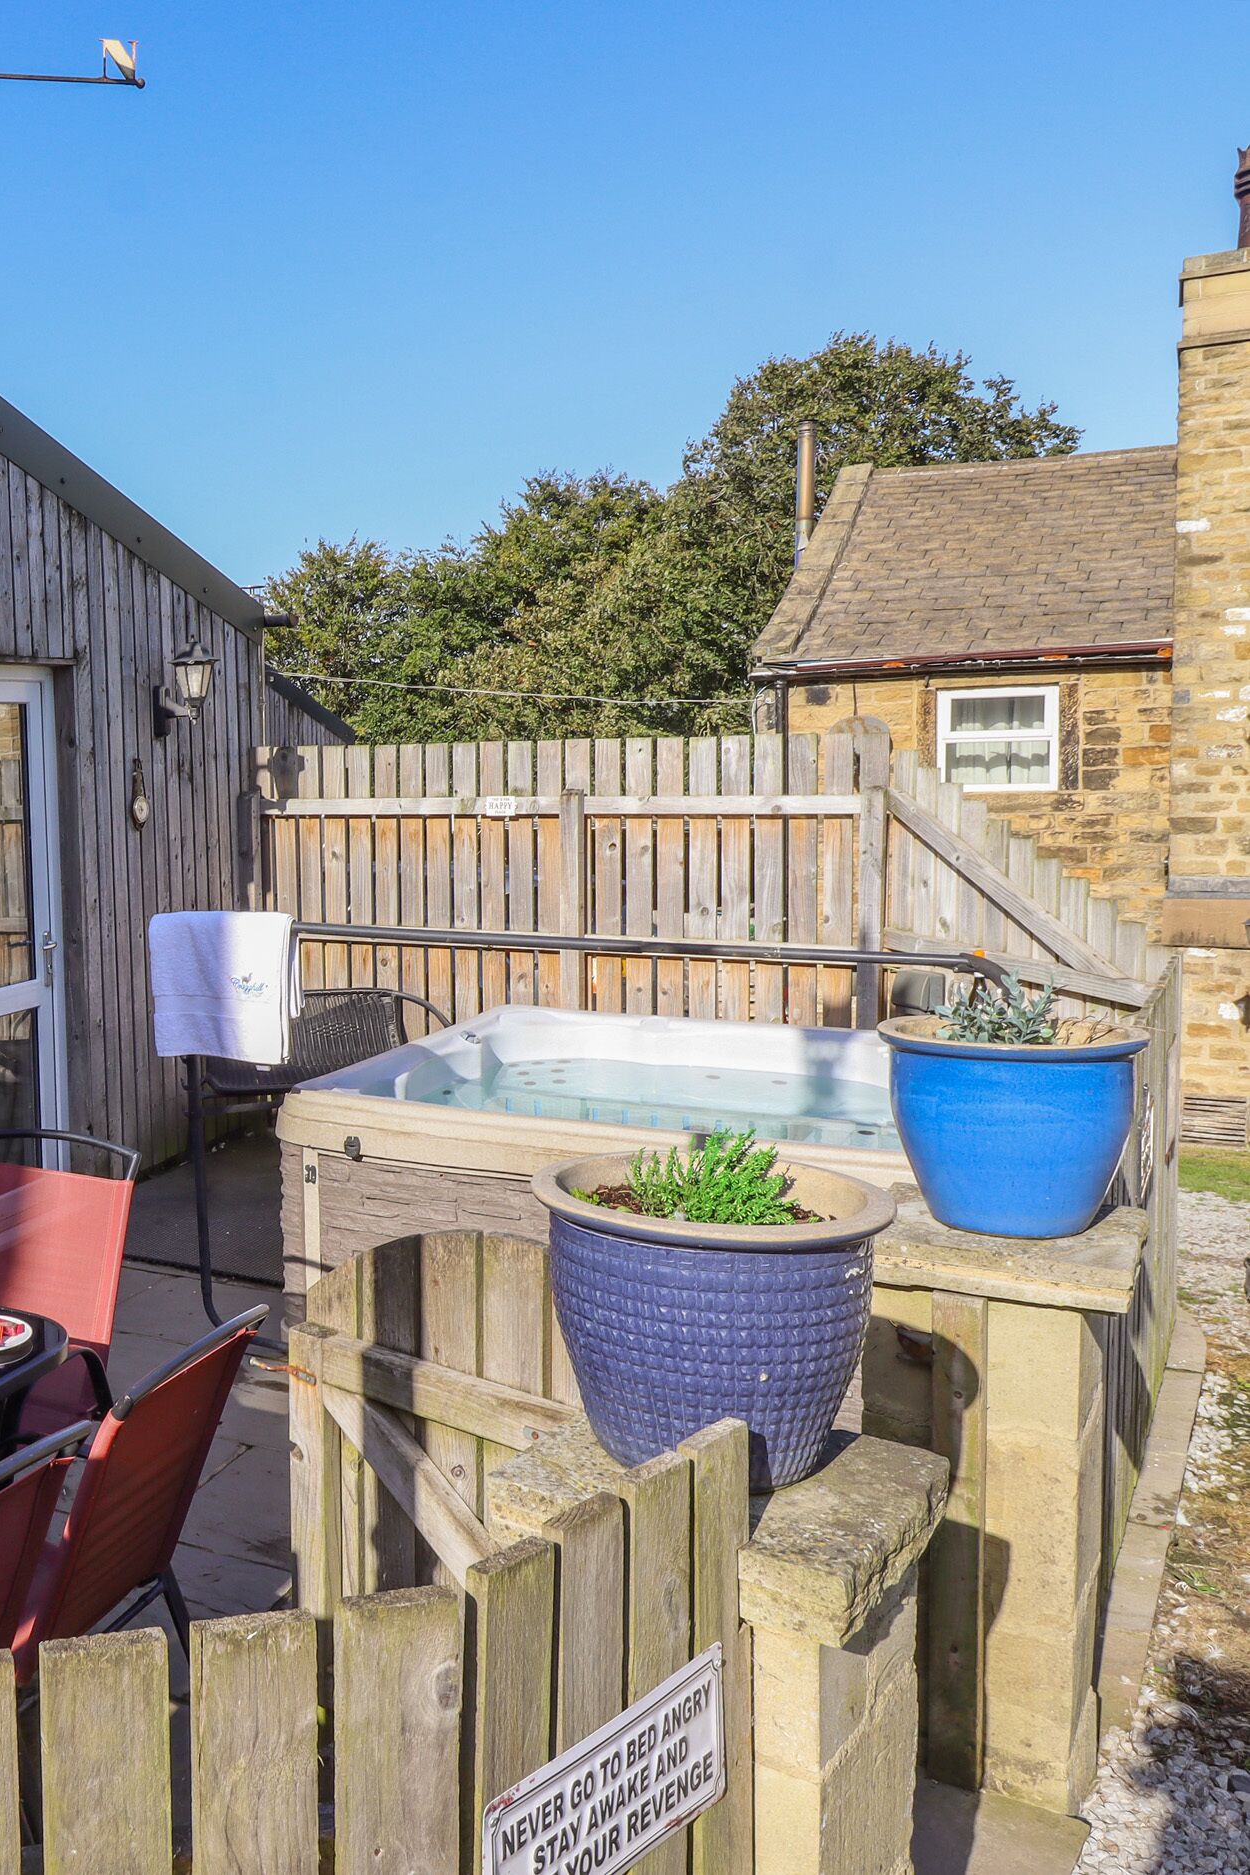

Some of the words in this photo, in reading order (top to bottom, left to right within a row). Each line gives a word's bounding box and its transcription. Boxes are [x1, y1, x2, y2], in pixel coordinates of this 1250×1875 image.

[99, 38, 139, 82] N
[489, 802, 512, 810] HAPPY
[501, 1791, 564, 1861] NEVER
[570, 1770, 594, 1811] GO
[600, 1750, 621, 1787] TO
[626, 1726, 657, 1770] BED
[661, 1679, 711, 1744] ANGRY
[533, 1815, 581, 1875] STAY
[586, 1769, 649, 1838] AWAKE
[654, 1735, 688, 1783] AND
[564, 1822, 620, 1875] YOUR
[626, 1750, 713, 1844] REVENGE
